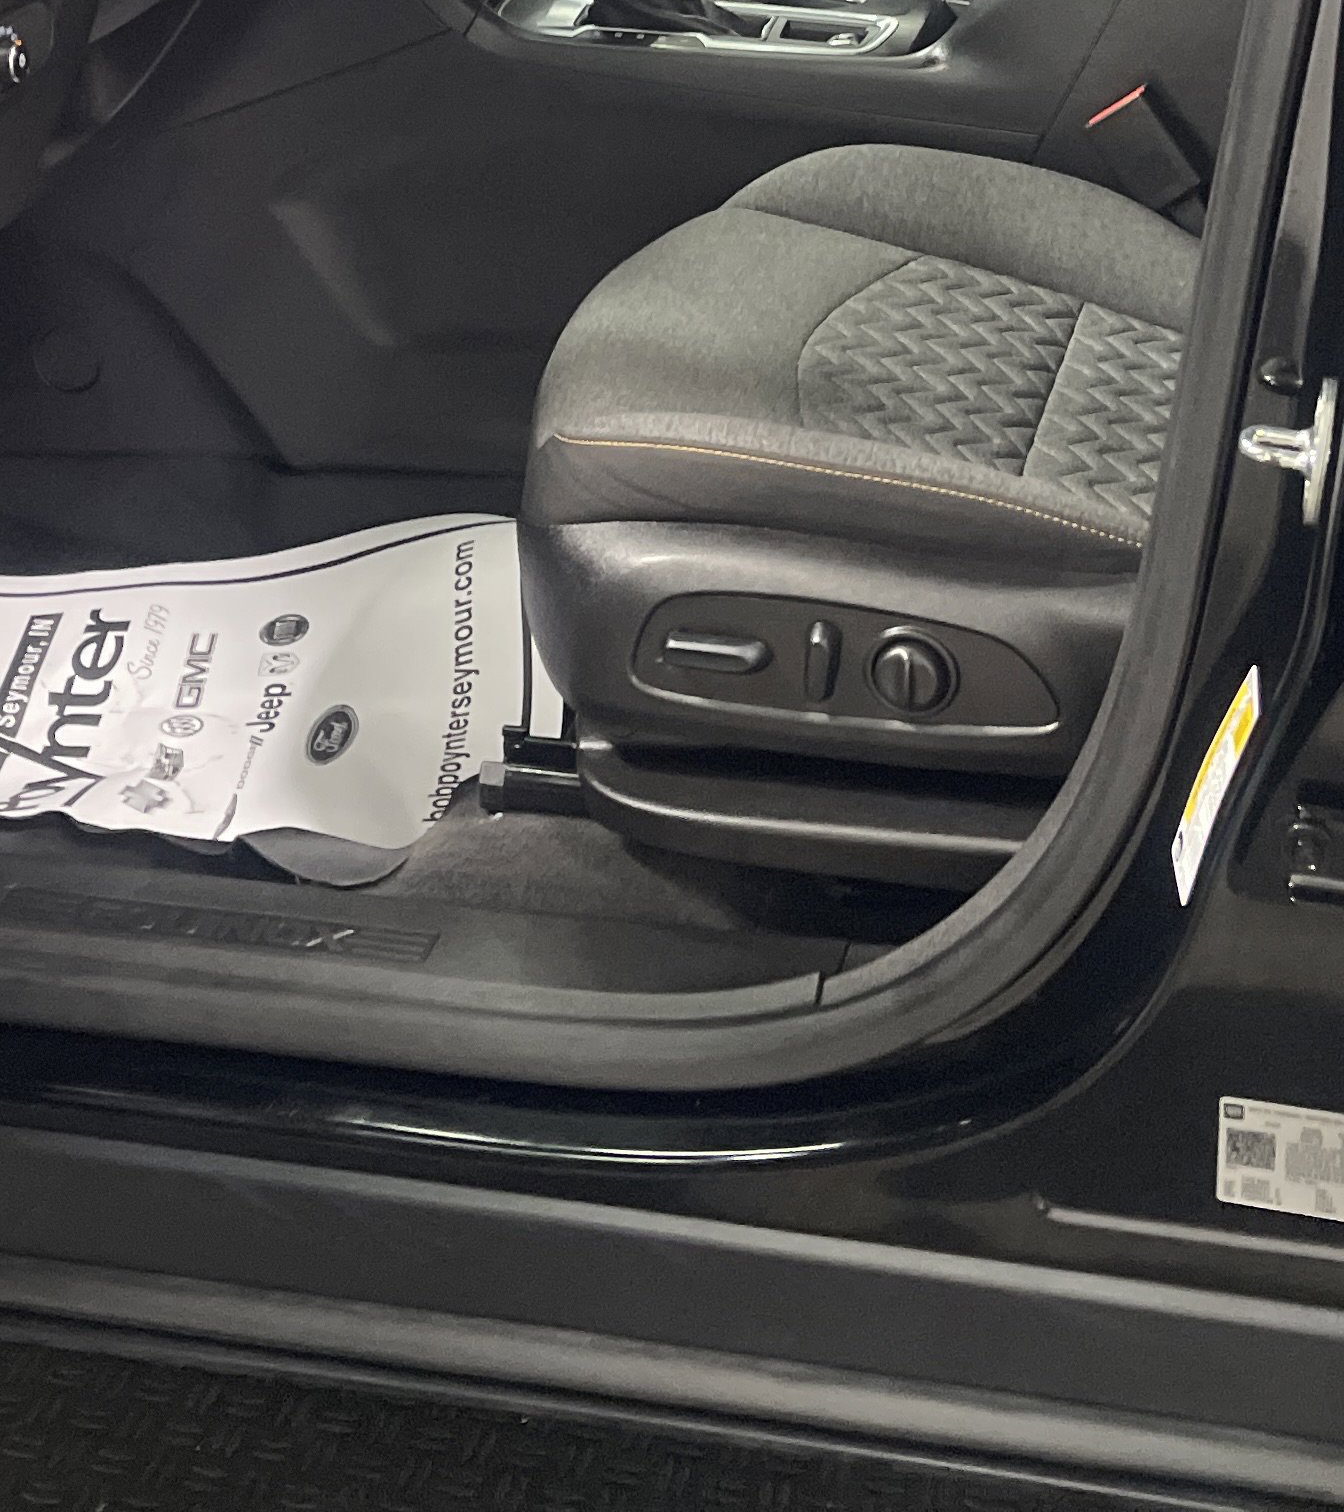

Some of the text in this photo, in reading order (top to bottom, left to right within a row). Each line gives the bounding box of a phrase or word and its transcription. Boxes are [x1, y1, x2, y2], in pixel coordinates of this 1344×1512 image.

[127, 603, 171, 680] Since 1979
[174, 632, 218, 709] GMC
[245, 682, 293, 733] Jeep
